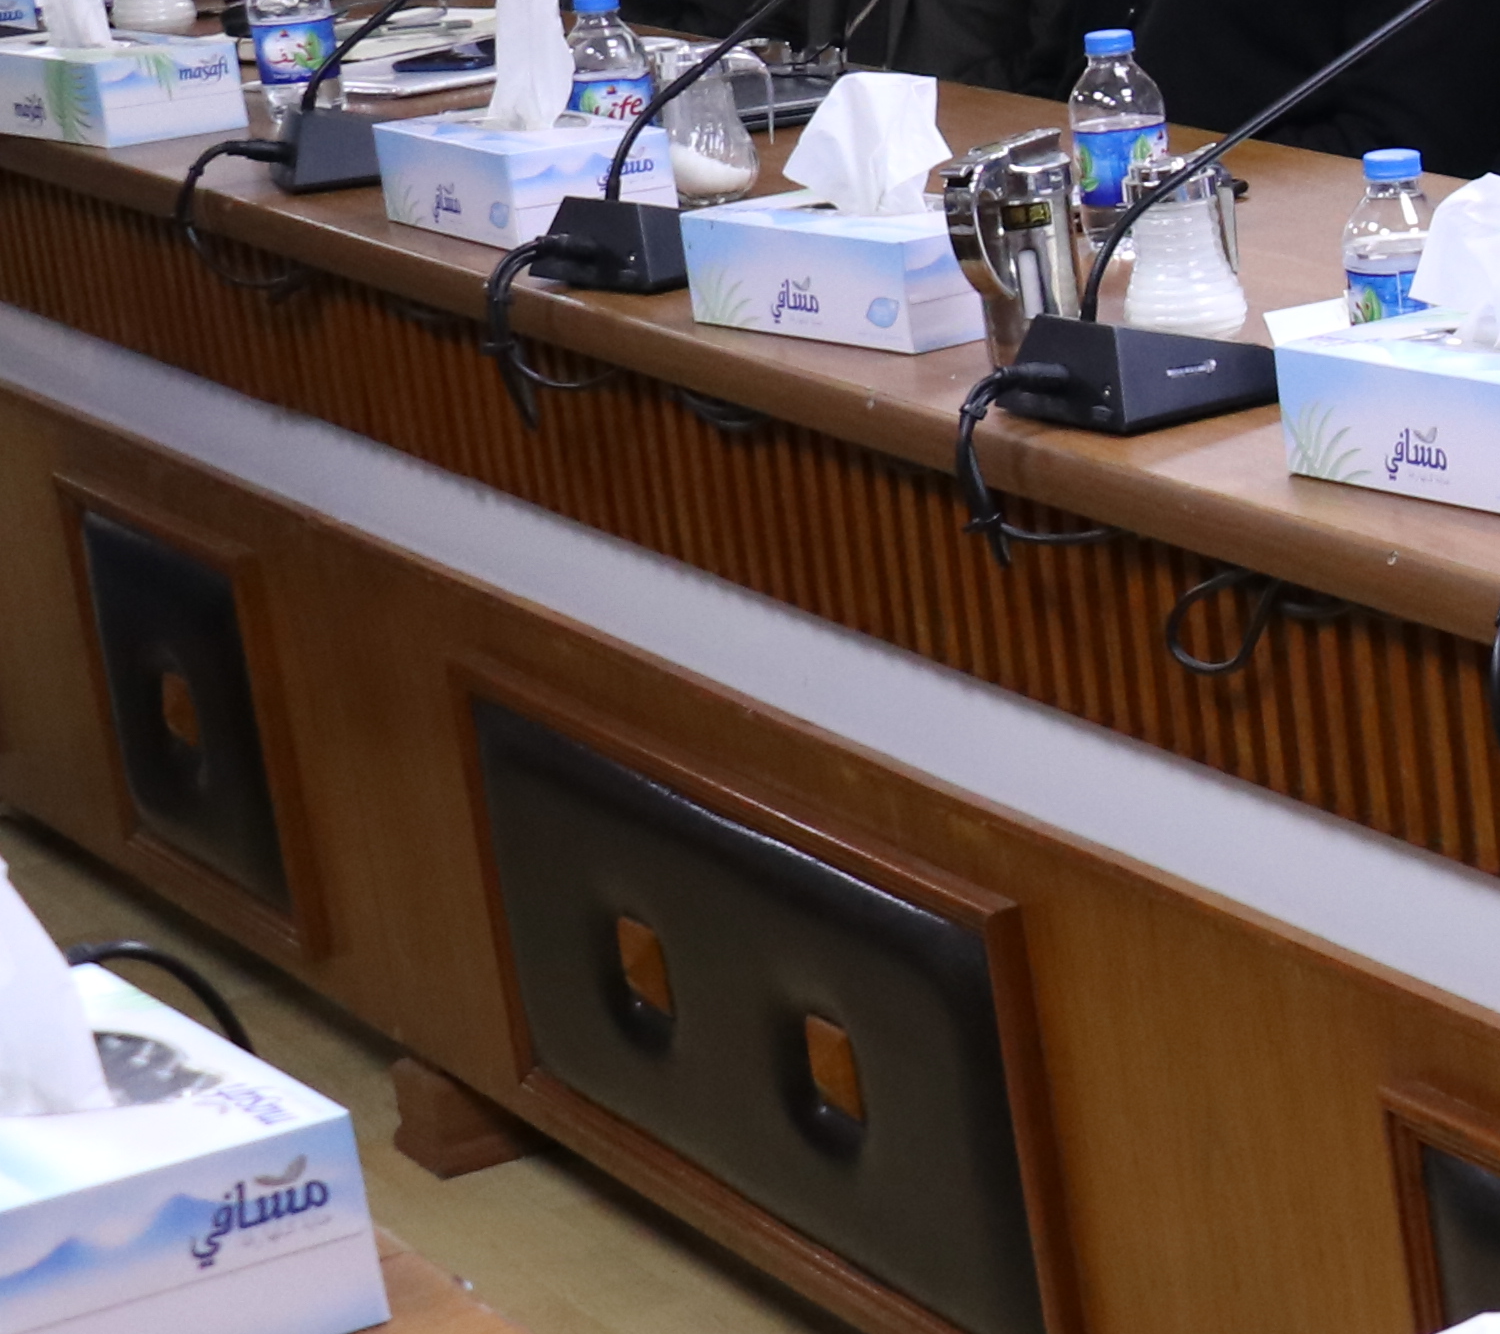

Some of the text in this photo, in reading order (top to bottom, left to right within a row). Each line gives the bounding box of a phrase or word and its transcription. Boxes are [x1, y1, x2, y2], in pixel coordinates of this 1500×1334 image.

[179, 56, 229, 81] masafi
[771, 279, 820, 324] مسافي
[1385, 428, 1448, 480] مسافي
[191, 1180, 329, 1270] مسافي
